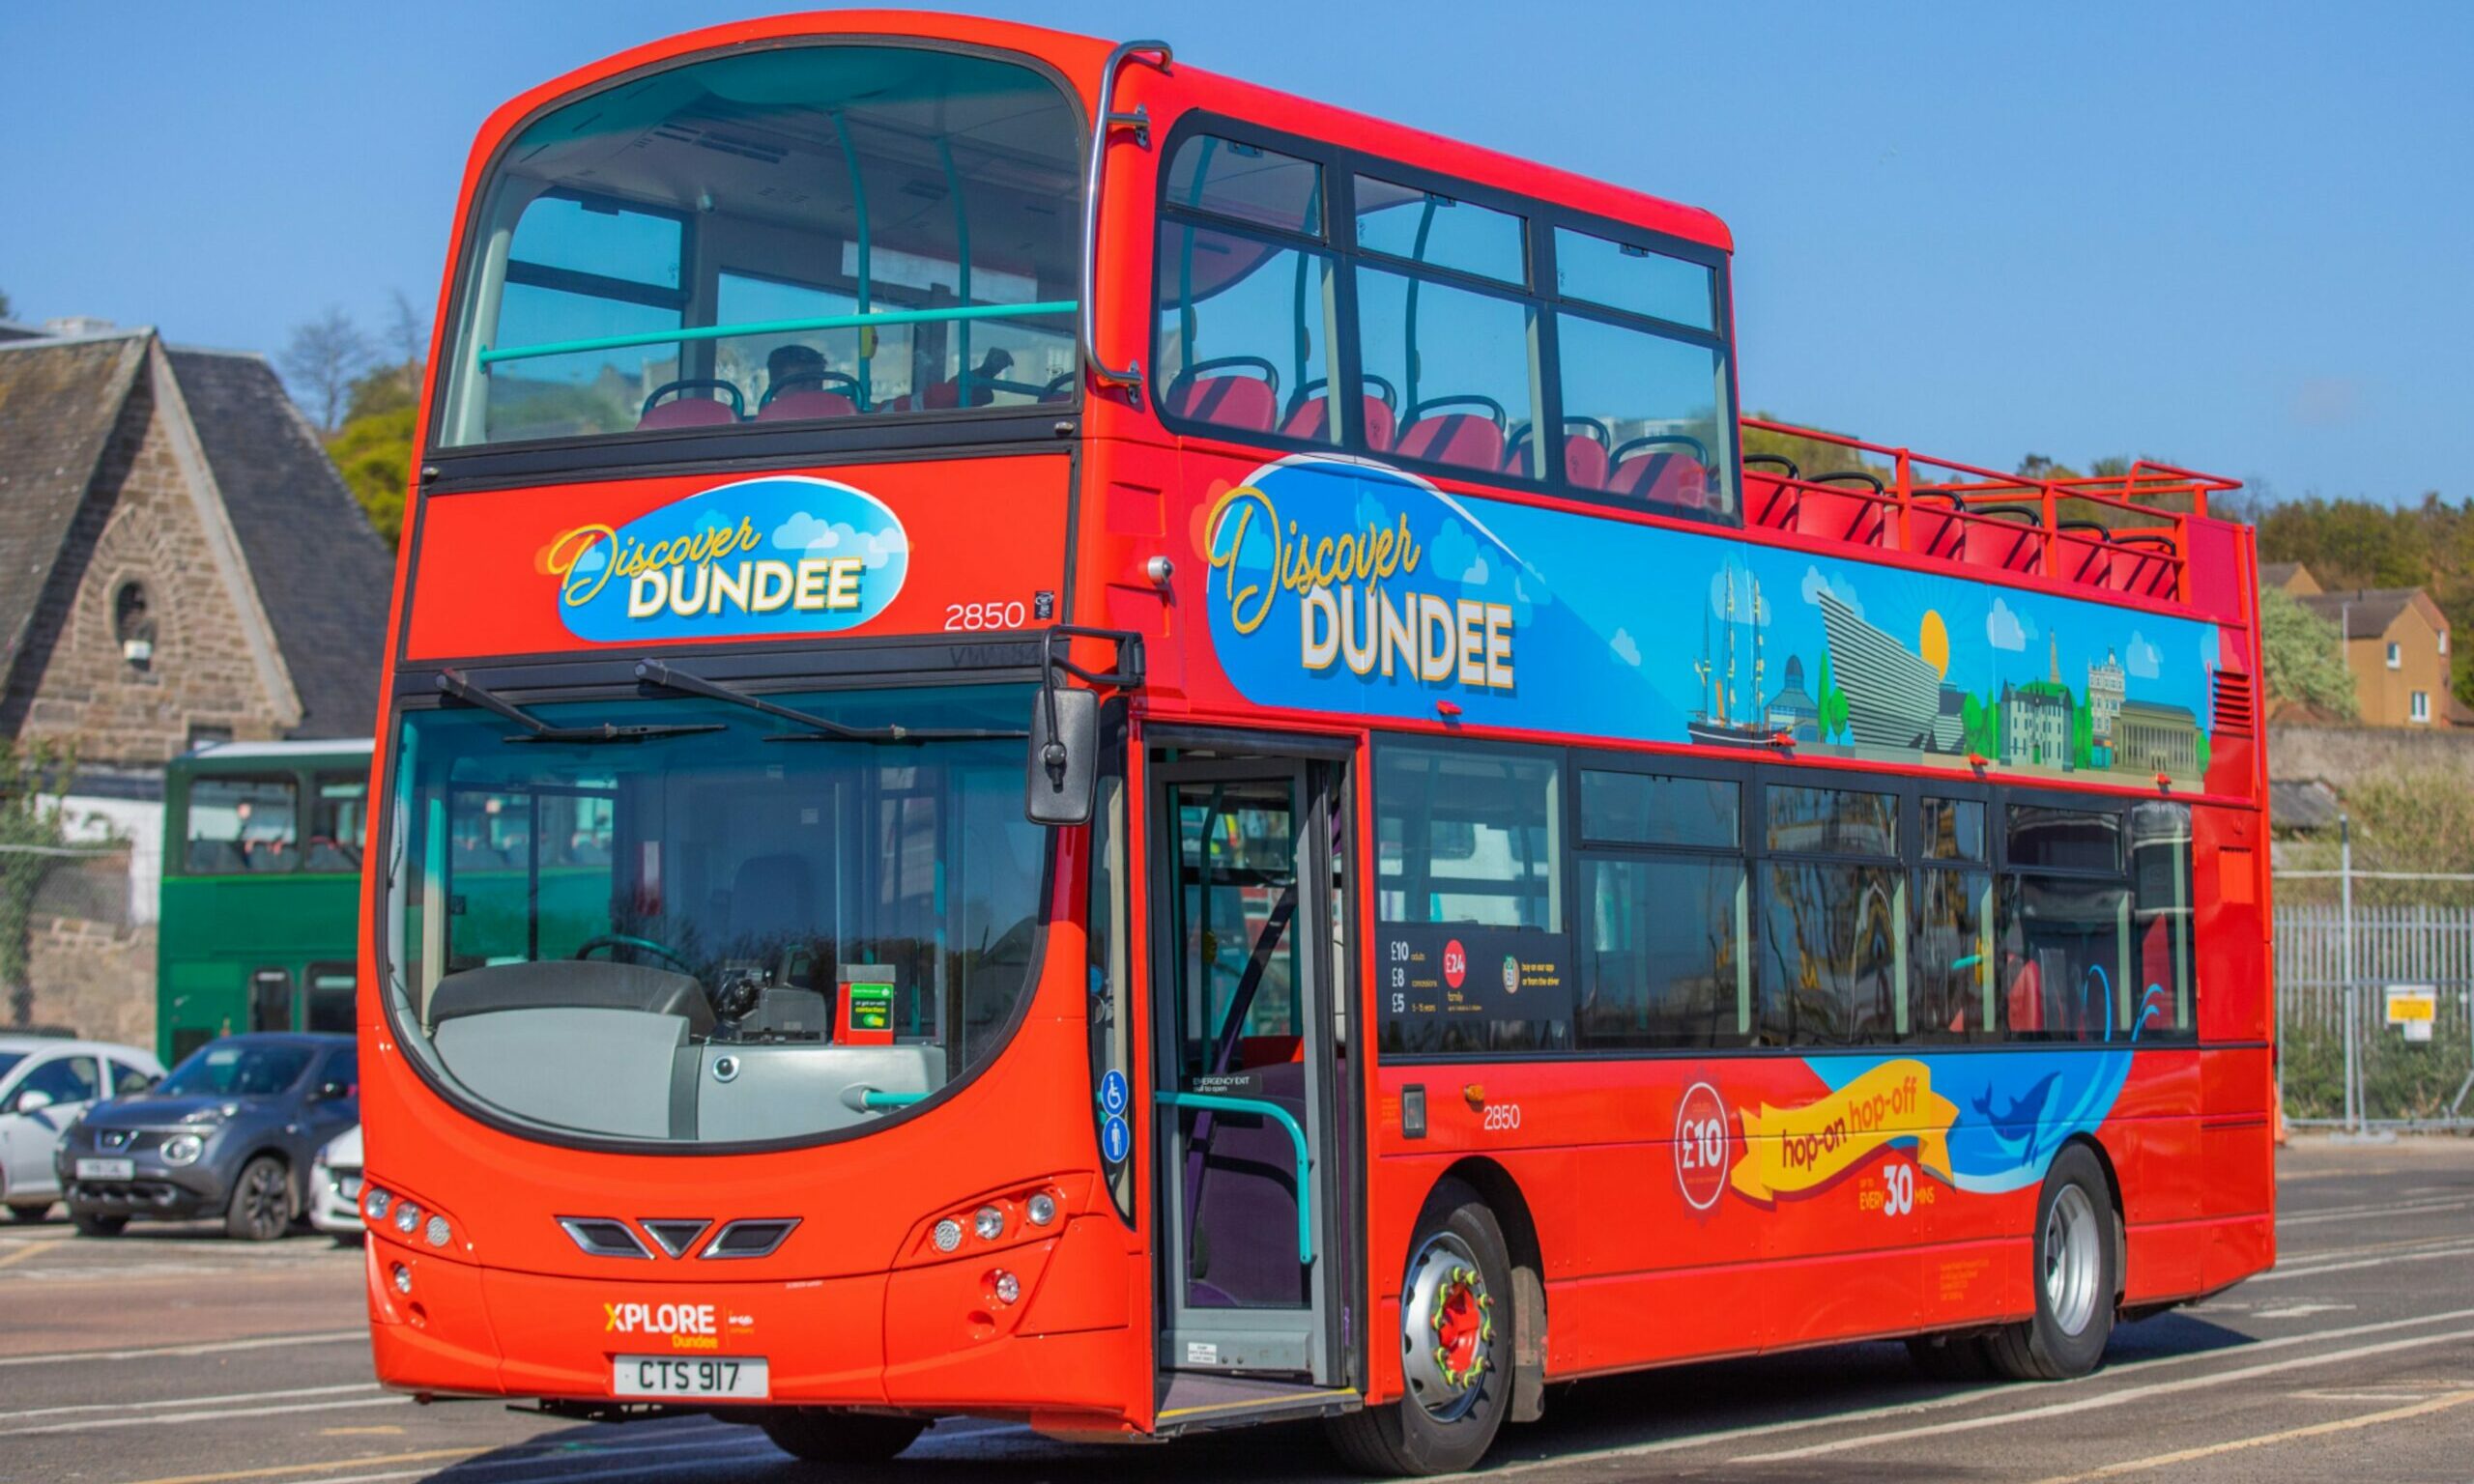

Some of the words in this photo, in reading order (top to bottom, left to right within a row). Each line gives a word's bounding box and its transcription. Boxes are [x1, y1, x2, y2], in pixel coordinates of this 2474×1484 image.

[548, 515, 761, 606] Discover
[1205, 486, 1420, 634] Discover
[626, 557, 863, 618] DUNDEE
[943, 602, 1025, 631] 2850
[1301, 585, 1513, 689] DUNDEE
[1391, 941, 1409, 960] £10
[1446, 954, 1464, 973] £24
[1392, 967, 1404, 987] £8
[1392, 993, 1405, 1013] £5
[1193, 1076, 1234, 1085] EMERGENCY
[1235, 1076, 1250, 1085] EXIT
[1483, 1104, 1520, 1130] 2850
[1782, 1117, 1847, 1172] hop-on
[1849, 1076, 1916, 1132] hop-off
[1683, 1119, 1722, 1169] £10
[1859, 1190, 1884, 1211] EVERY
[1884, 1163, 1913, 1216] 30
[603, 1302, 716, 1334] XPLORE
[672, 1334, 718, 1349] Dundee
[639, 1361, 689, 1390] CTS
[699, 1361, 740, 1391] 917
